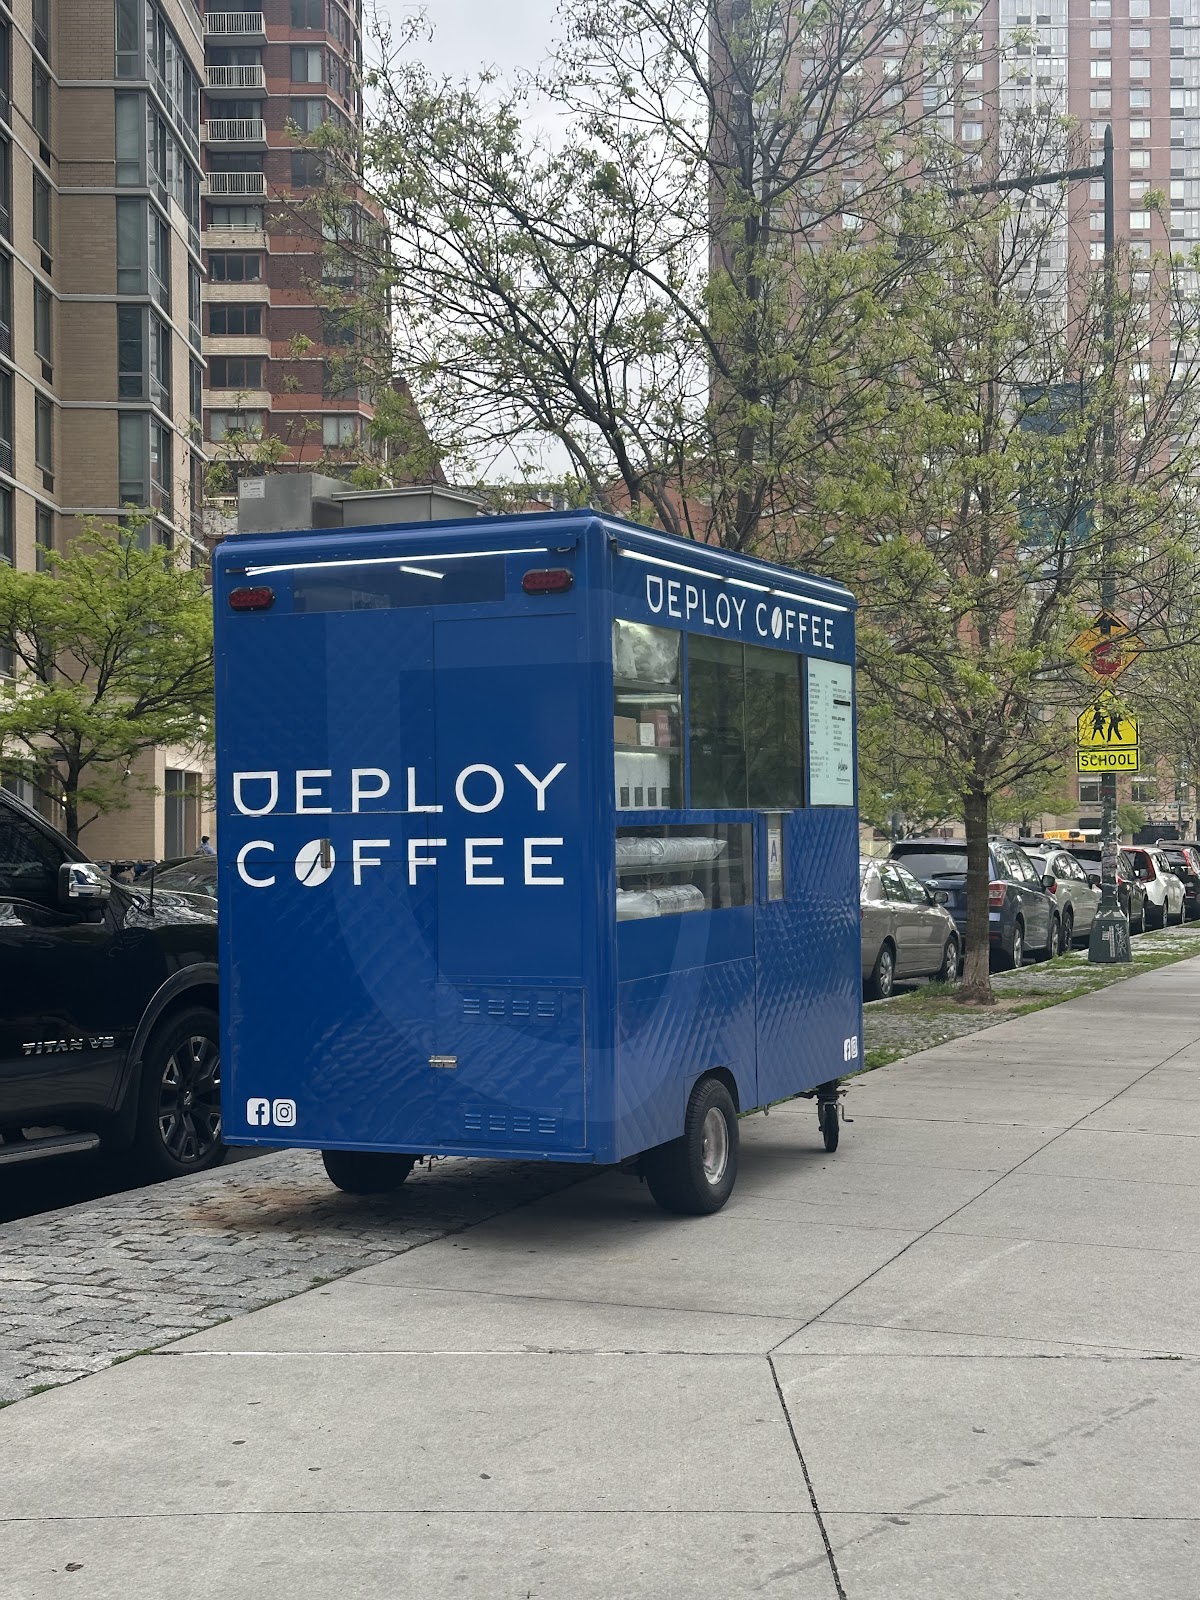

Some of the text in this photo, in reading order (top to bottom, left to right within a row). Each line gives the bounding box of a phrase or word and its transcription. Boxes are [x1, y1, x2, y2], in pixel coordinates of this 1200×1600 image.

[646, 574, 835, 650] DEPLOY COFFEE
[1081, 754, 1135, 766] SCHOOL
[232, 762, 567, 815] DEPLOY
[236, 837, 564, 888] COFFEE
[770, 839, 778, 863] A
[22, 1036, 115, 1055] TITAN V8
